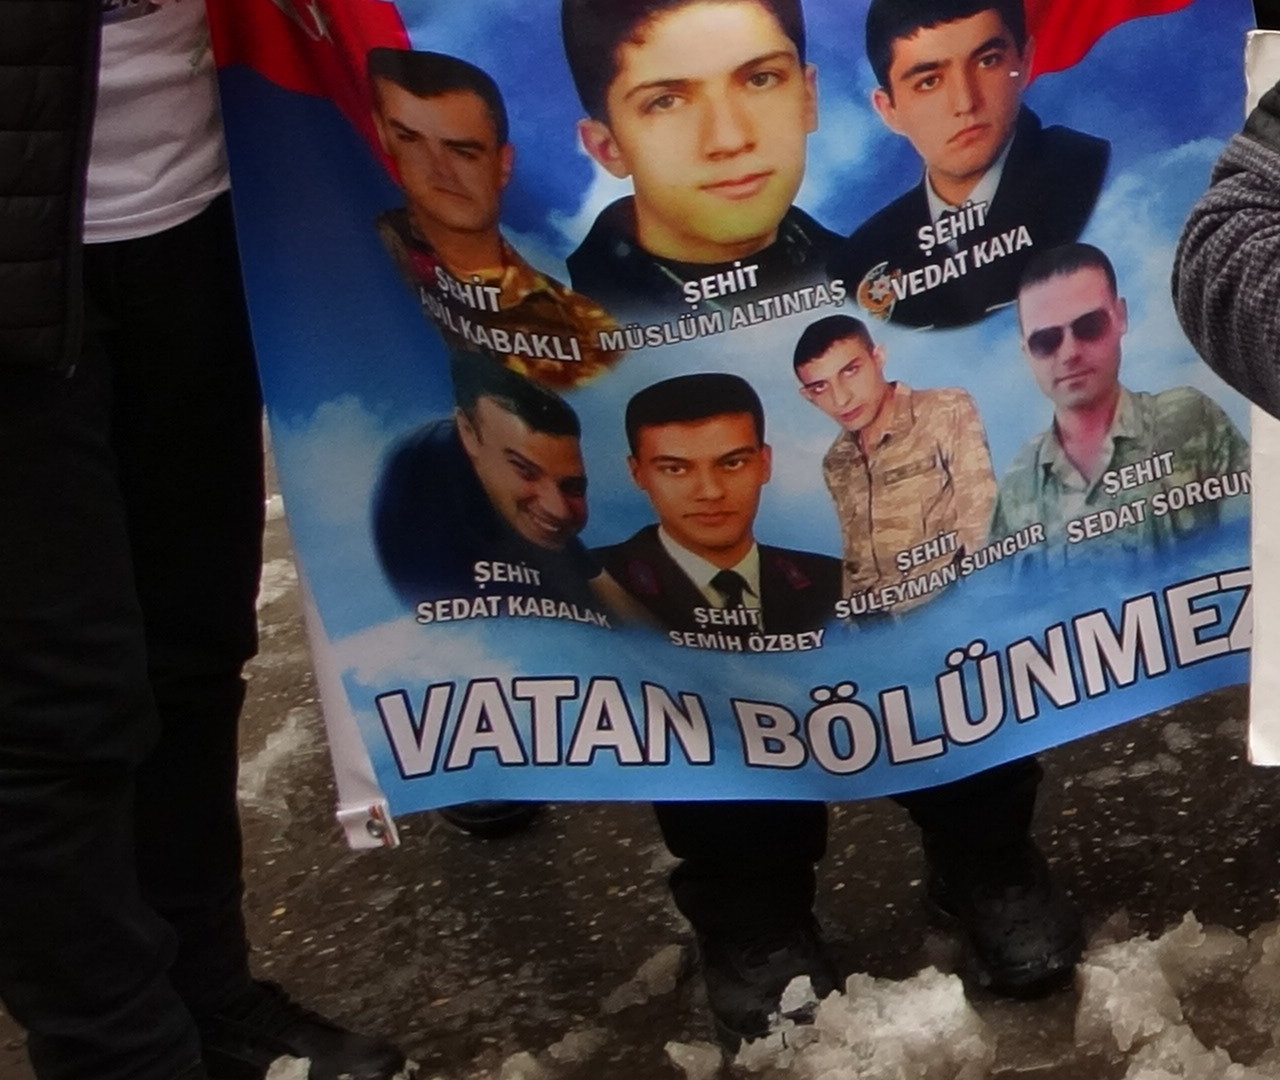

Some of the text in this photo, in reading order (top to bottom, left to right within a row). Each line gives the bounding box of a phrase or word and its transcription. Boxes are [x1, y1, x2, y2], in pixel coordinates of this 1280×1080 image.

[918, 200, 988, 257] ŞEHİT
[683, 261, 759, 310] ŞEHİT
[891, 225, 1034, 301] VEDAT KAYA
[434, 266, 501, 312] ŞEHİT
[459, 315, 583, 362] KABAKLI
[599, 279, 847, 352] MÜSLÜM ALTINTAŞ
[1102, 450, 1175, 499] ŞEHİT
[1066, 499, 1147, 544] SEDAT
[473, 560, 542, 589] ŞEHİT
[834, 523, 1045, 619] SÜLEYMAN SUNGUR
[896, 530, 959, 576] ŞEHİT
[415, 595, 613, 630] SEDAT KABALAK
[693, 606, 763, 629] ŞEHİT
[668, 628, 825, 653] SEMİH ÖZBEY
[376, 566, 1252, 779] VATAN BÖLÜNMEZ
